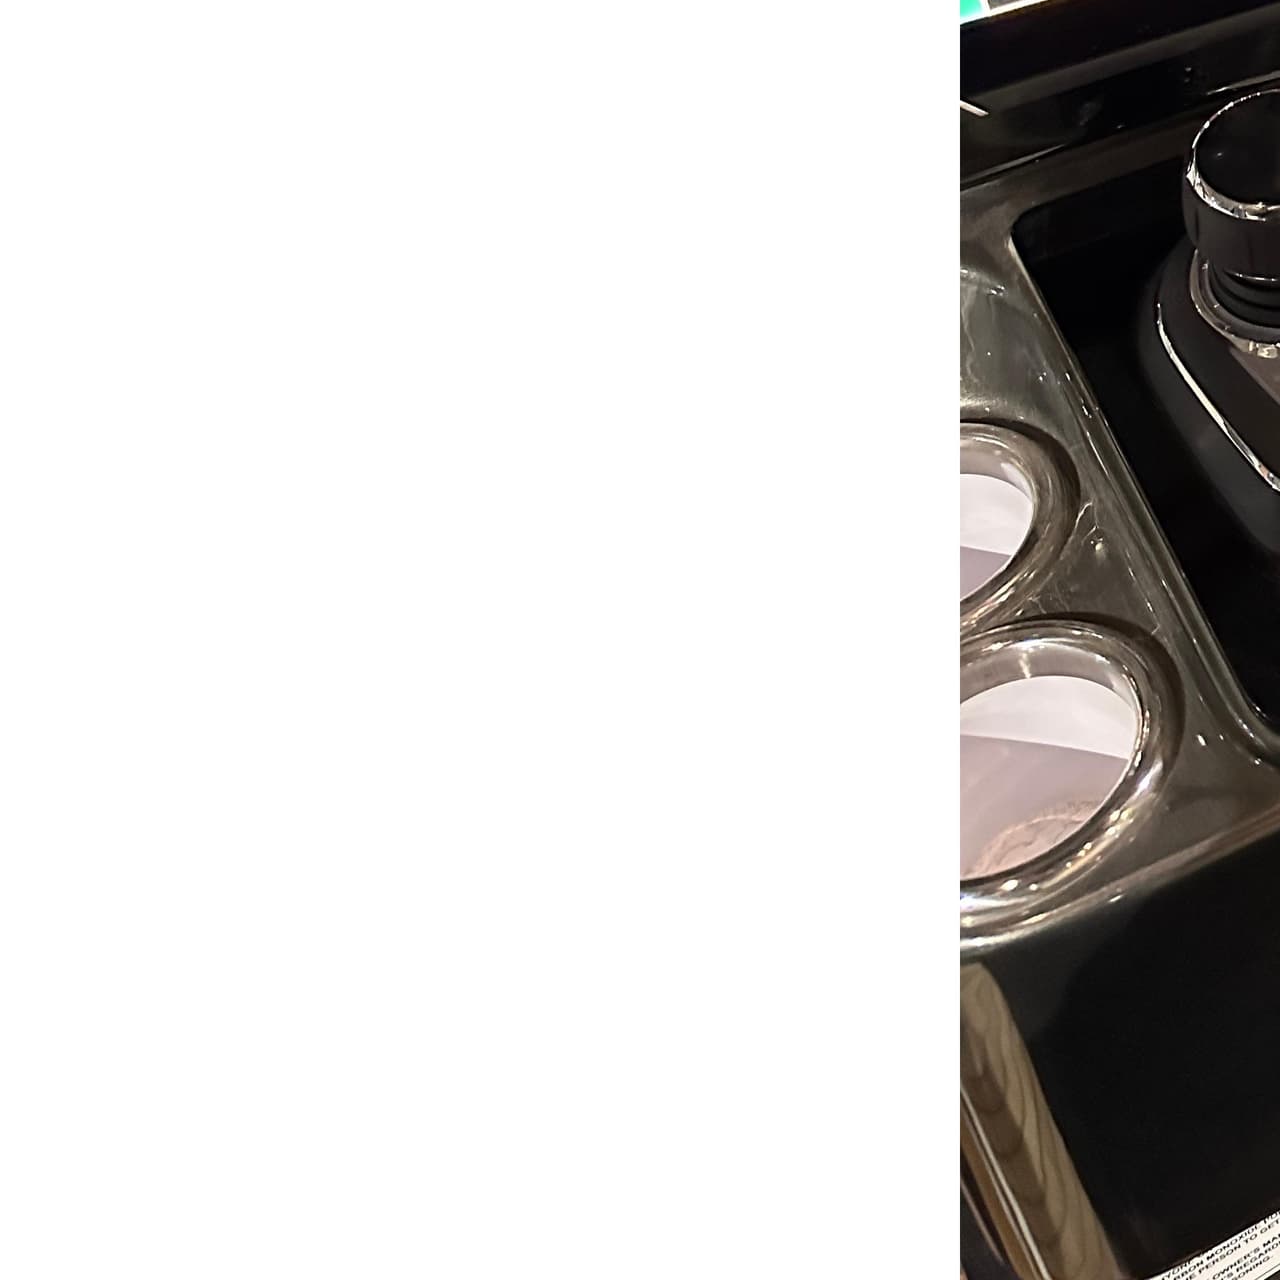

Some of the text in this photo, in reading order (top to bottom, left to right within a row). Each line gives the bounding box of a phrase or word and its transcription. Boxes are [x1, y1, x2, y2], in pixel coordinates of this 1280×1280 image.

[1198, 1243, 1241, 1274] PERSON
[1243, 1232, 1258, 1244] TO
[1260, 1219, 1279, 1234] GET
[1212, 1246, 1260, 1280] OWNER'S
